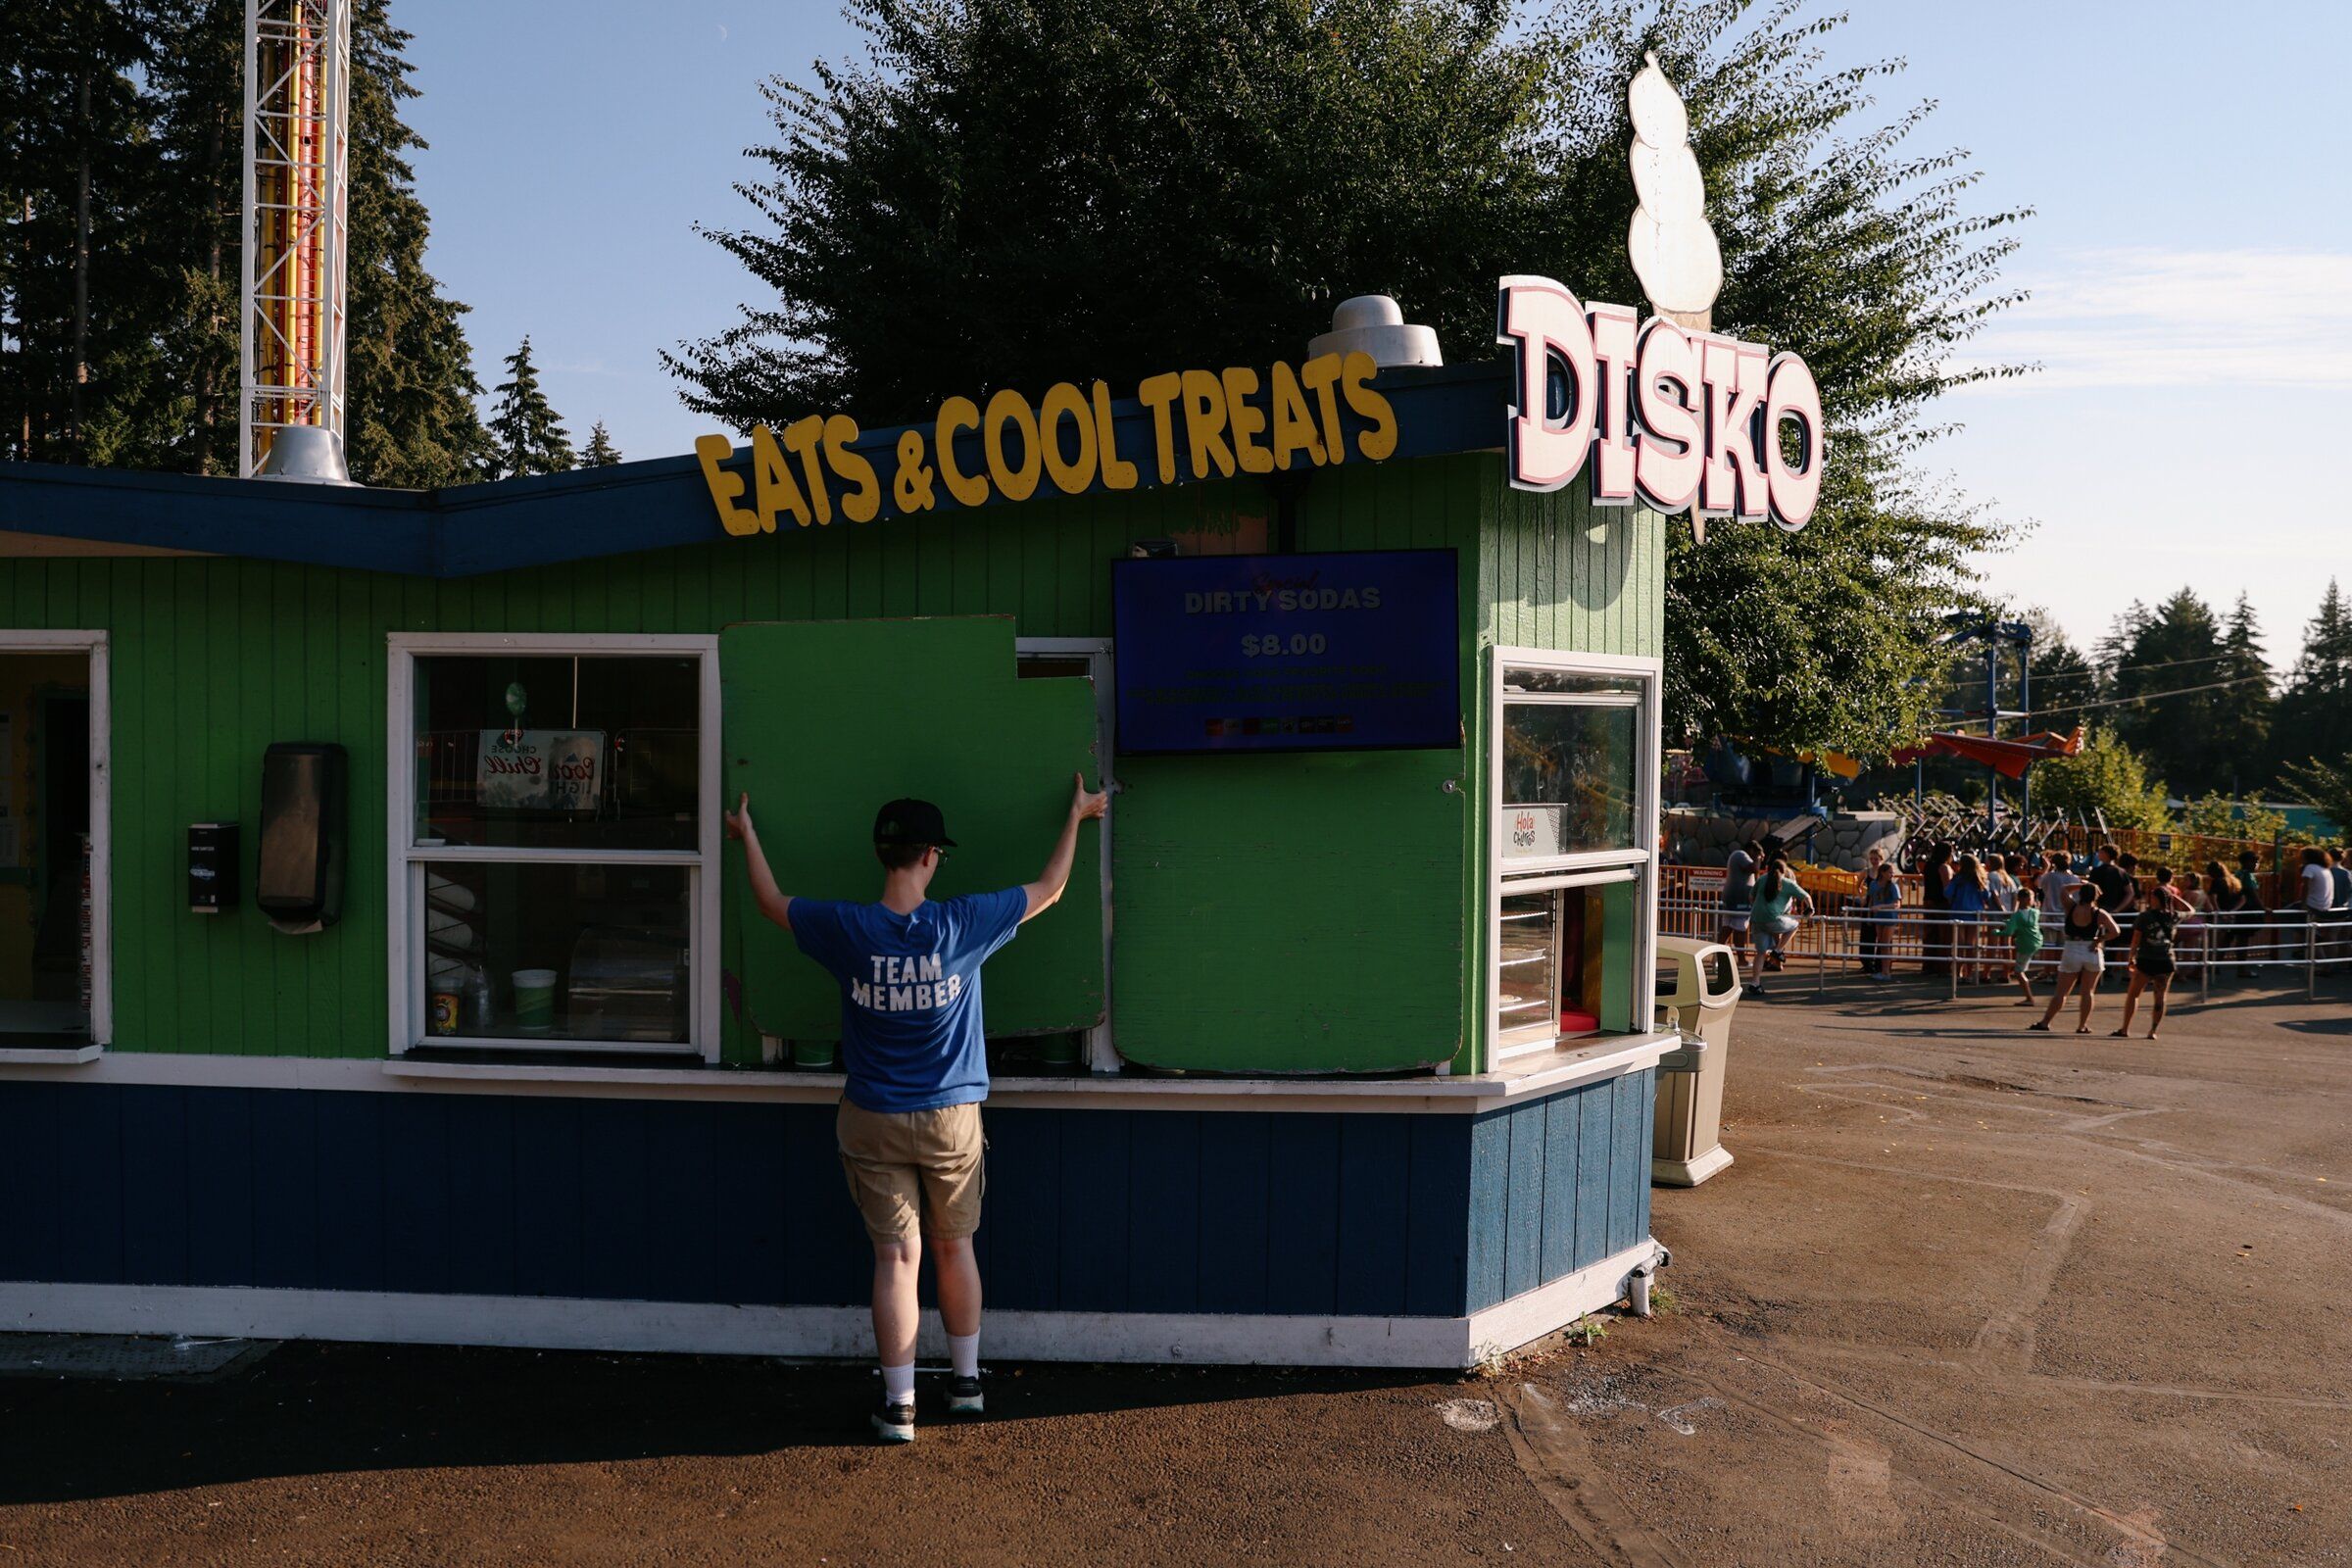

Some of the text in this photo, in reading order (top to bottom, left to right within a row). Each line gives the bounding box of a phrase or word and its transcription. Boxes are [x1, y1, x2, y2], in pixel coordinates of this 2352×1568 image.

[1496, 274, 1824, 532] DISKO
[695, 350, 1398, 536] EATS & COOL TREATS
[1185, 587, 1382, 614] DIRTY SODAS
[1241, 633, 1327, 659] $8.00
[1516, 811, 1535, 831] Hola
[870, 953, 943, 984] TEAM
[852, 973, 961, 1011] MEMBER
